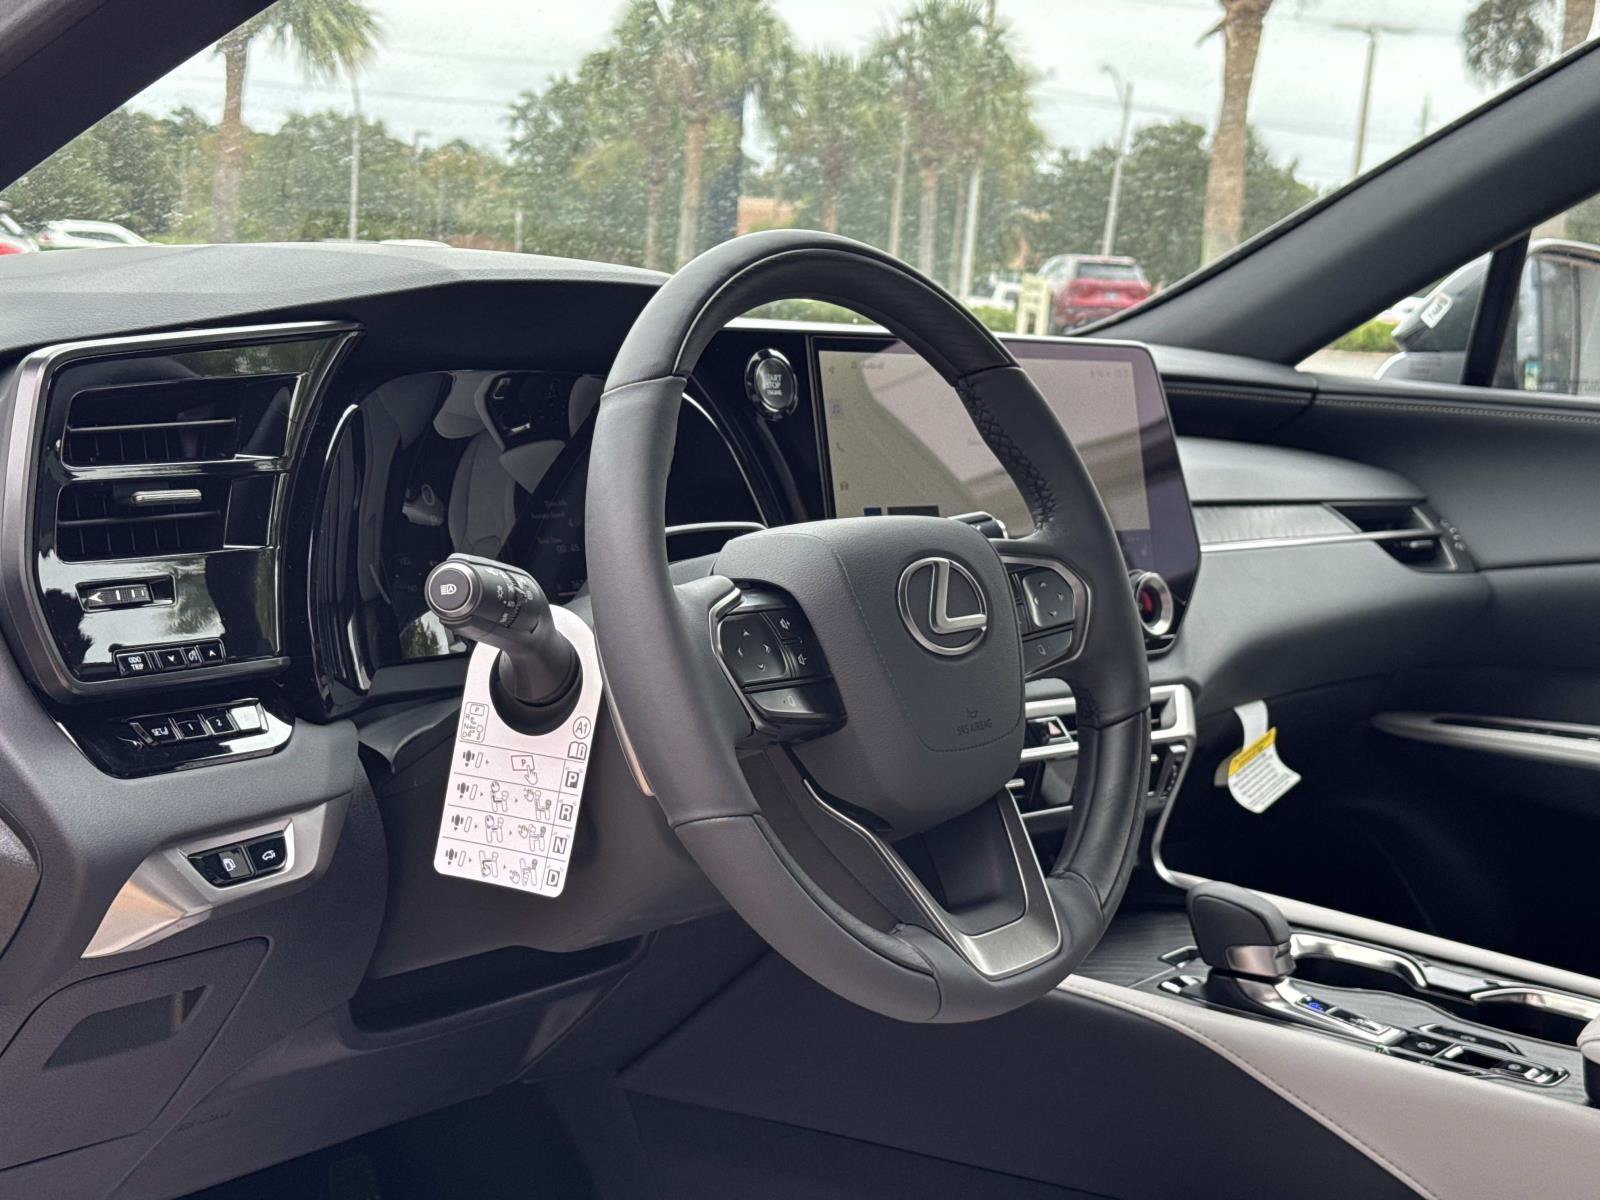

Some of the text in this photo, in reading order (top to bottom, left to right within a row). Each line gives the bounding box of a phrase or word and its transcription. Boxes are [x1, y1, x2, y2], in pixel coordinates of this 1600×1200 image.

[128, 655, 142, 664] ODO
[130, 663, 144, 671] TRIP
[575, 721, 588, 734] A1
[567, 774, 578, 787] P
[560, 806, 572, 820] R
[554, 838, 566, 854] N
[548, 872, 559, 886] D
